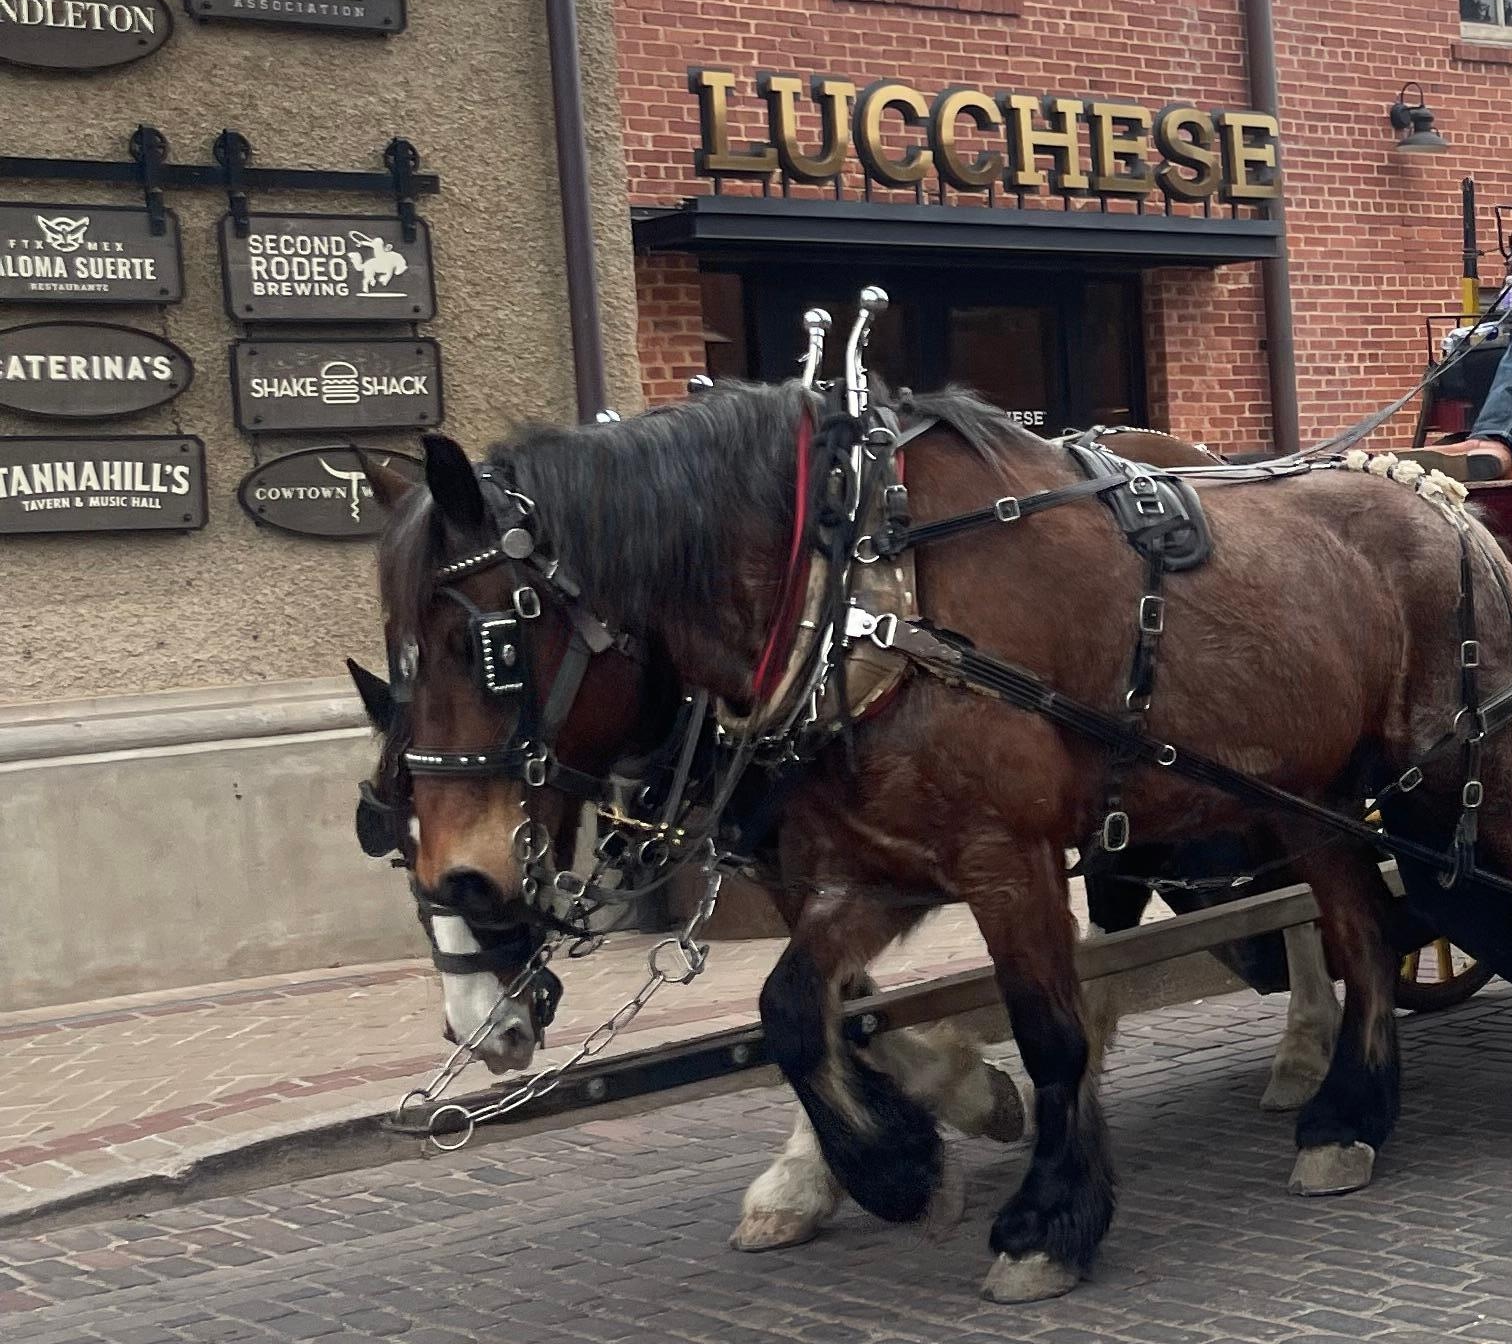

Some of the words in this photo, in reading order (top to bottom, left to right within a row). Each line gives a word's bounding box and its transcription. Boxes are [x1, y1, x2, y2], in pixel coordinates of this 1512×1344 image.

[688, 67, 1281, 201] LUCCHESE
[8, 239, 44, 250] FTX
[87, 242, 124, 252] MEX
[249, 234, 346, 256] SECOND
[75, 257, 157, 280] SUERTE
[251, 257, 348, 281] RODEO
[29, 282, 109, 292] RESTAURANTE
[253, 282, 349, 297] BREWING
[0, 355, 173, 381] ATERINA'S
[251, 377, 319, 398] SHAKE
[361, 375, 429, 396] SHACK
[22, 497, 71, 512] TAVERN
[75, 496, 84, 508] &
[89, 496, 128, 508] MUSIC
[132, 497, 162, 510] HALL
[255, 486, 348, 501] COWTOWN
